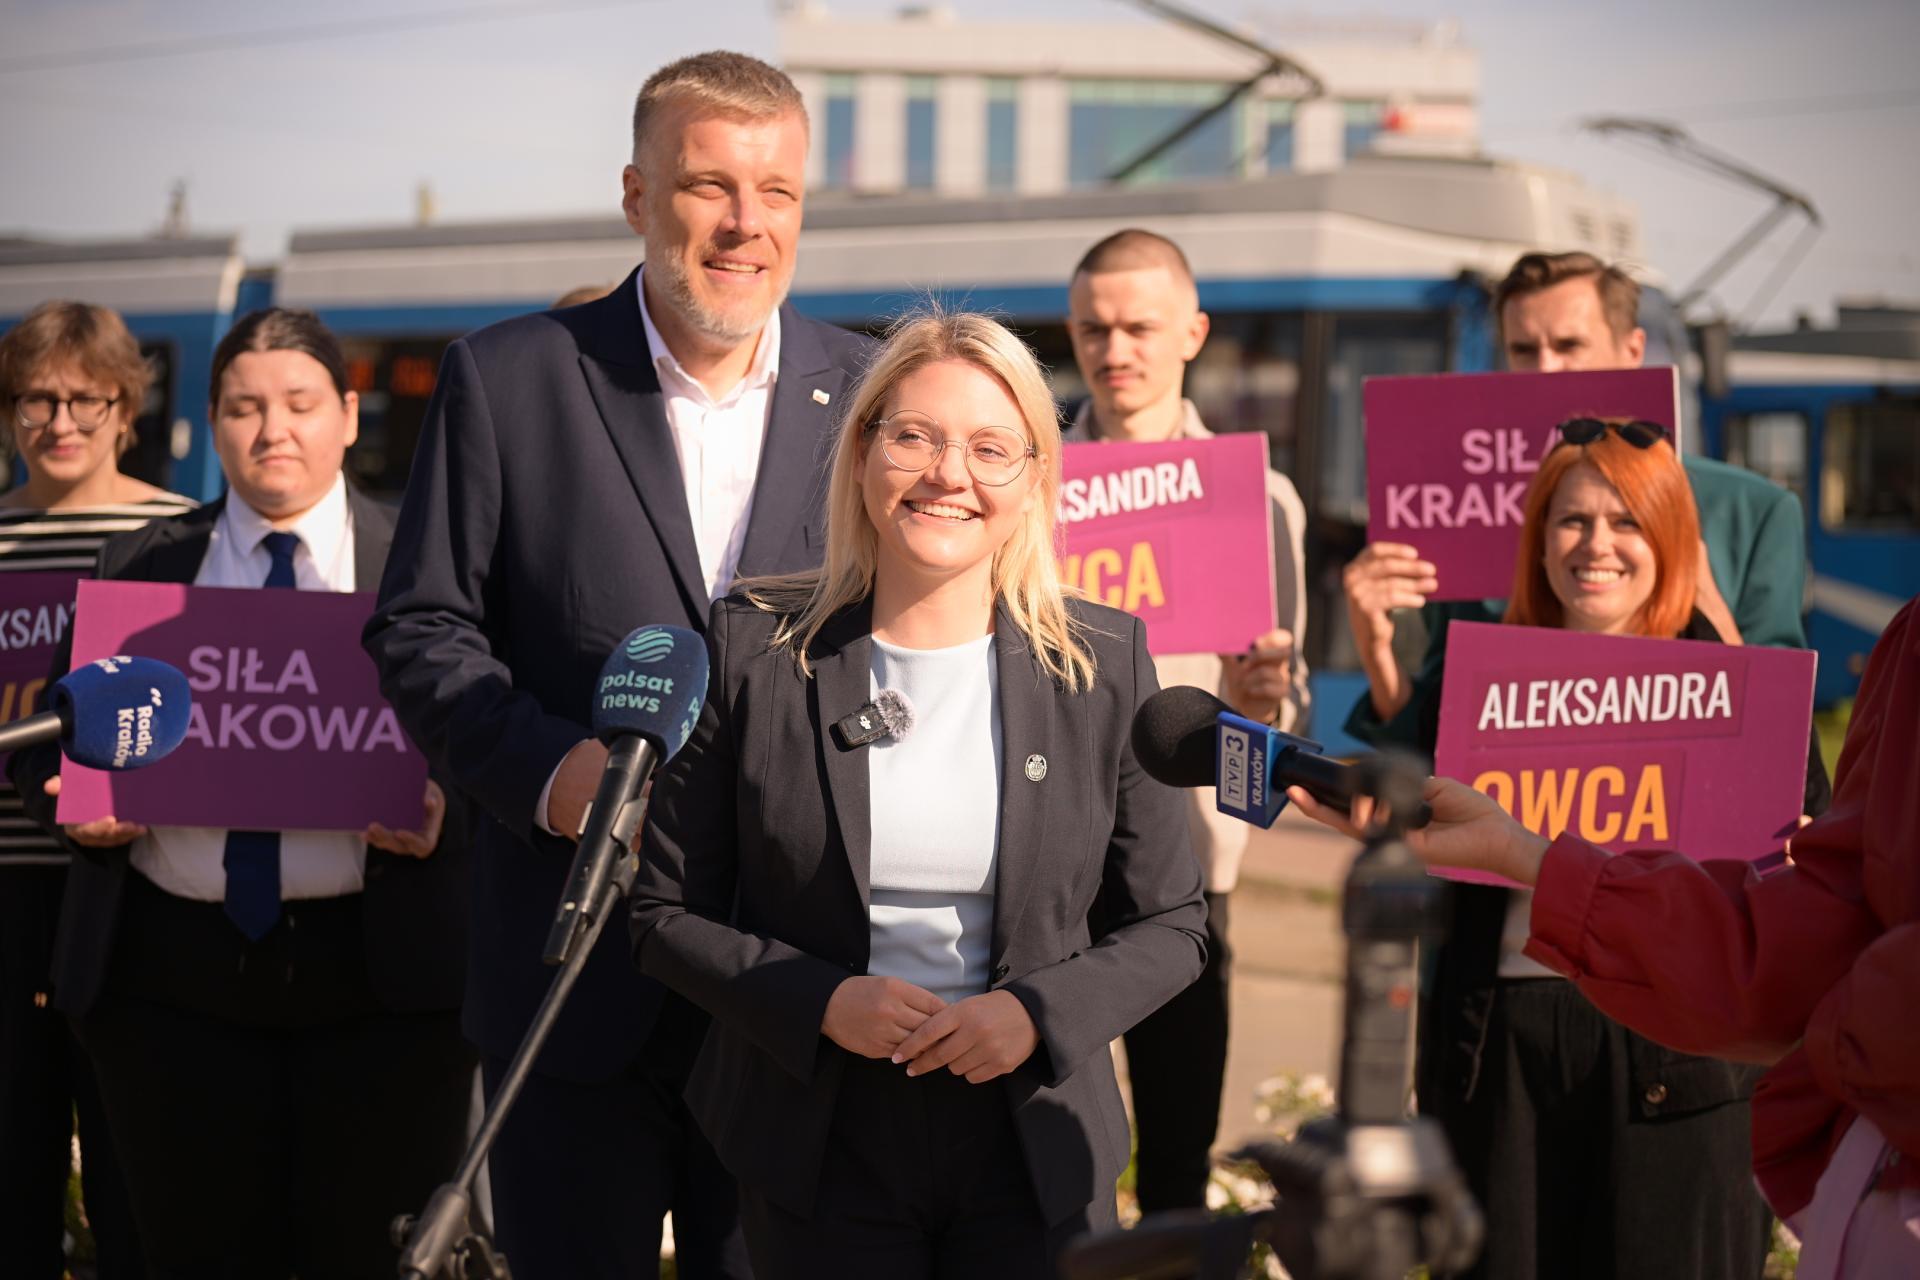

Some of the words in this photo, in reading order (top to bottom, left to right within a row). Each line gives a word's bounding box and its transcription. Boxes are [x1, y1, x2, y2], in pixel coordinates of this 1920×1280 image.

[1056, 458, 1204, 523] SANDRA
[1386, 482, 1527, 528] KRAK
[1058, 541, 1166, 612] CA
[188, 645, 319, 694] SIŁA
[600, 670, 674, 695] polsat
[602, 693, 660, 713] news
[1478, 671, 1732, 731] ALEKSANDRA
[135, 705, 153, 756] Radio
[1250, 747, 1265, 806] KRAKÓW
